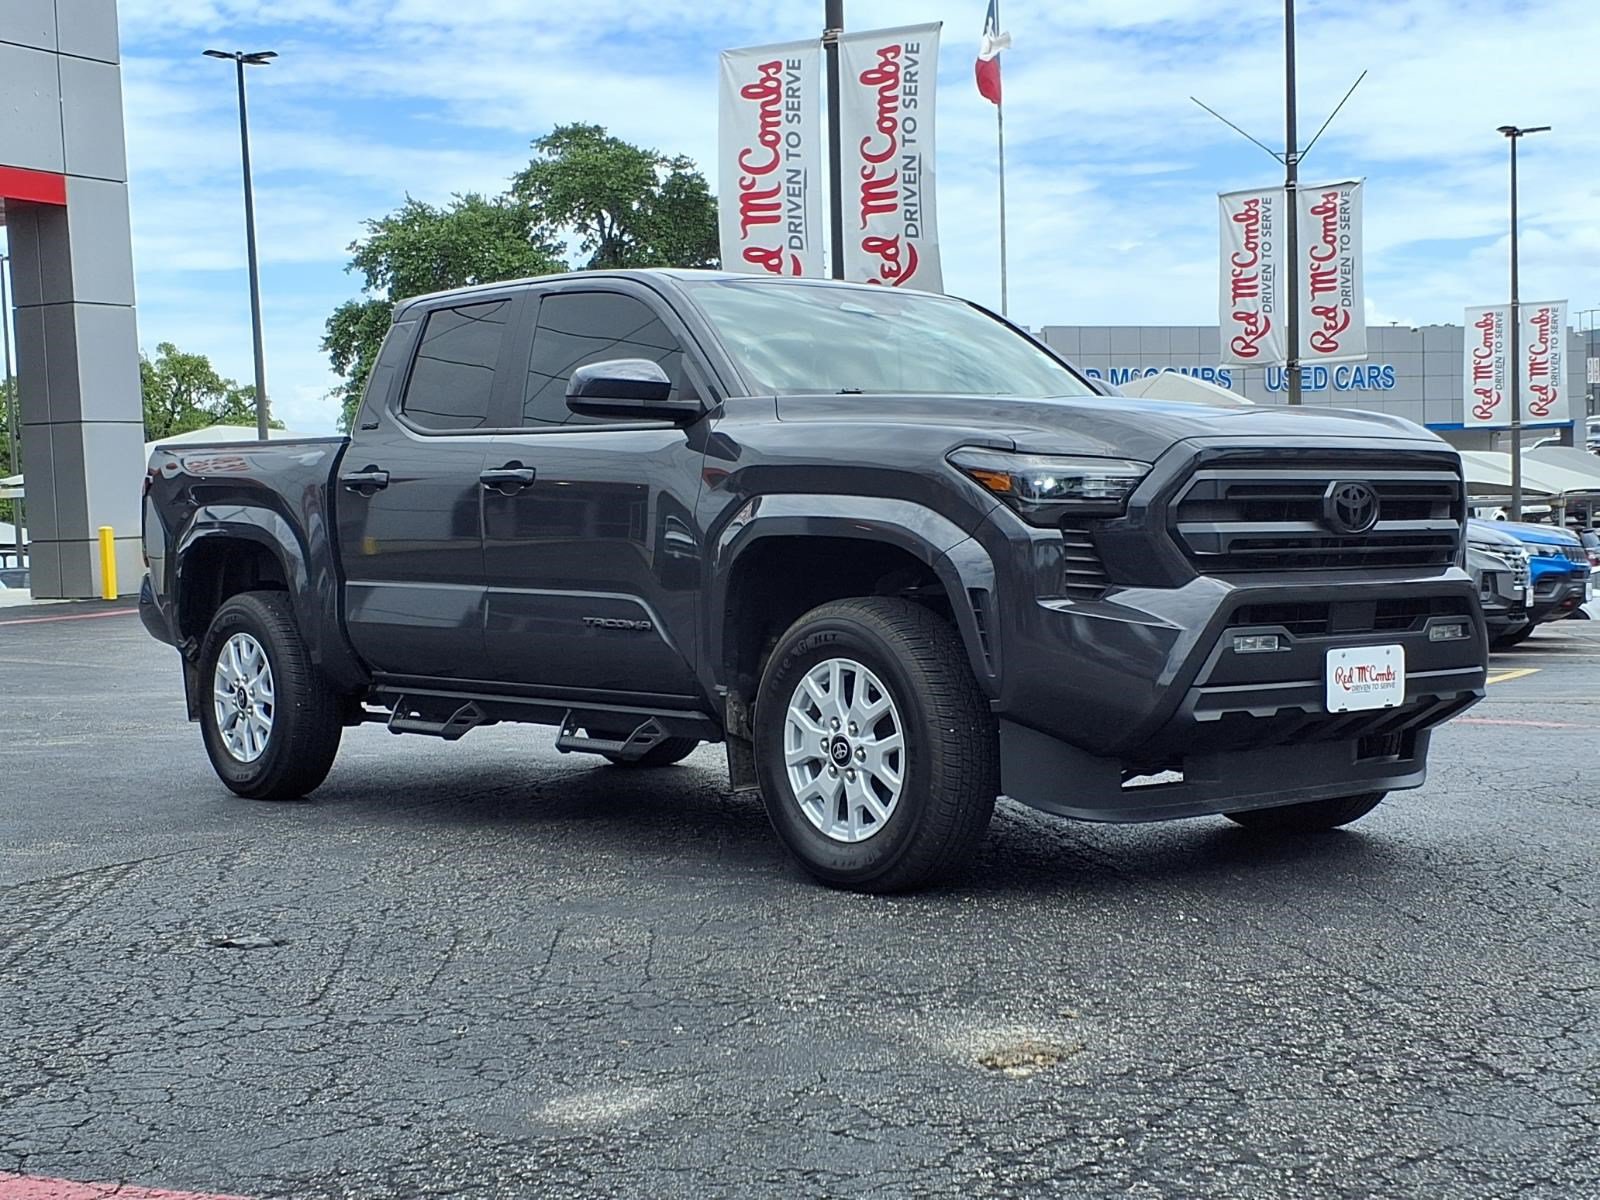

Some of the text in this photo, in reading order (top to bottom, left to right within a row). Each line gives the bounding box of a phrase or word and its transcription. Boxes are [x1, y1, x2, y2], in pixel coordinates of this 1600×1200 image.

[738, 60, 783, 240] McCombs
[786, 59, 804, 250] DRIVEN TO SERVE
[860, 45, 901, 230] McCombs
[902, 42, 920, 239] DRIVEN TO SERVE
[1231, 198, 1271, 358] Red McCombs
[1261, 197, 1273, 313] DRIVEN TO SERVE
[1309, 192, 1351, 353] Red McCombs
[1340, 191, 1352, 307] DRIVEN TO SERVE
[1335, 365, 1396, 390] CARS
[1472, 312, 1501, 419] Red McCombs
[1495, 311, 1503, 390] DRIVEN TO SERVE
[1528, 308, 1557, 417] Red McCombs
[1550, 307, 1559, 387] DRIVEN TO SERVE
[1335, 664, 1397, 690] Red McCombs
